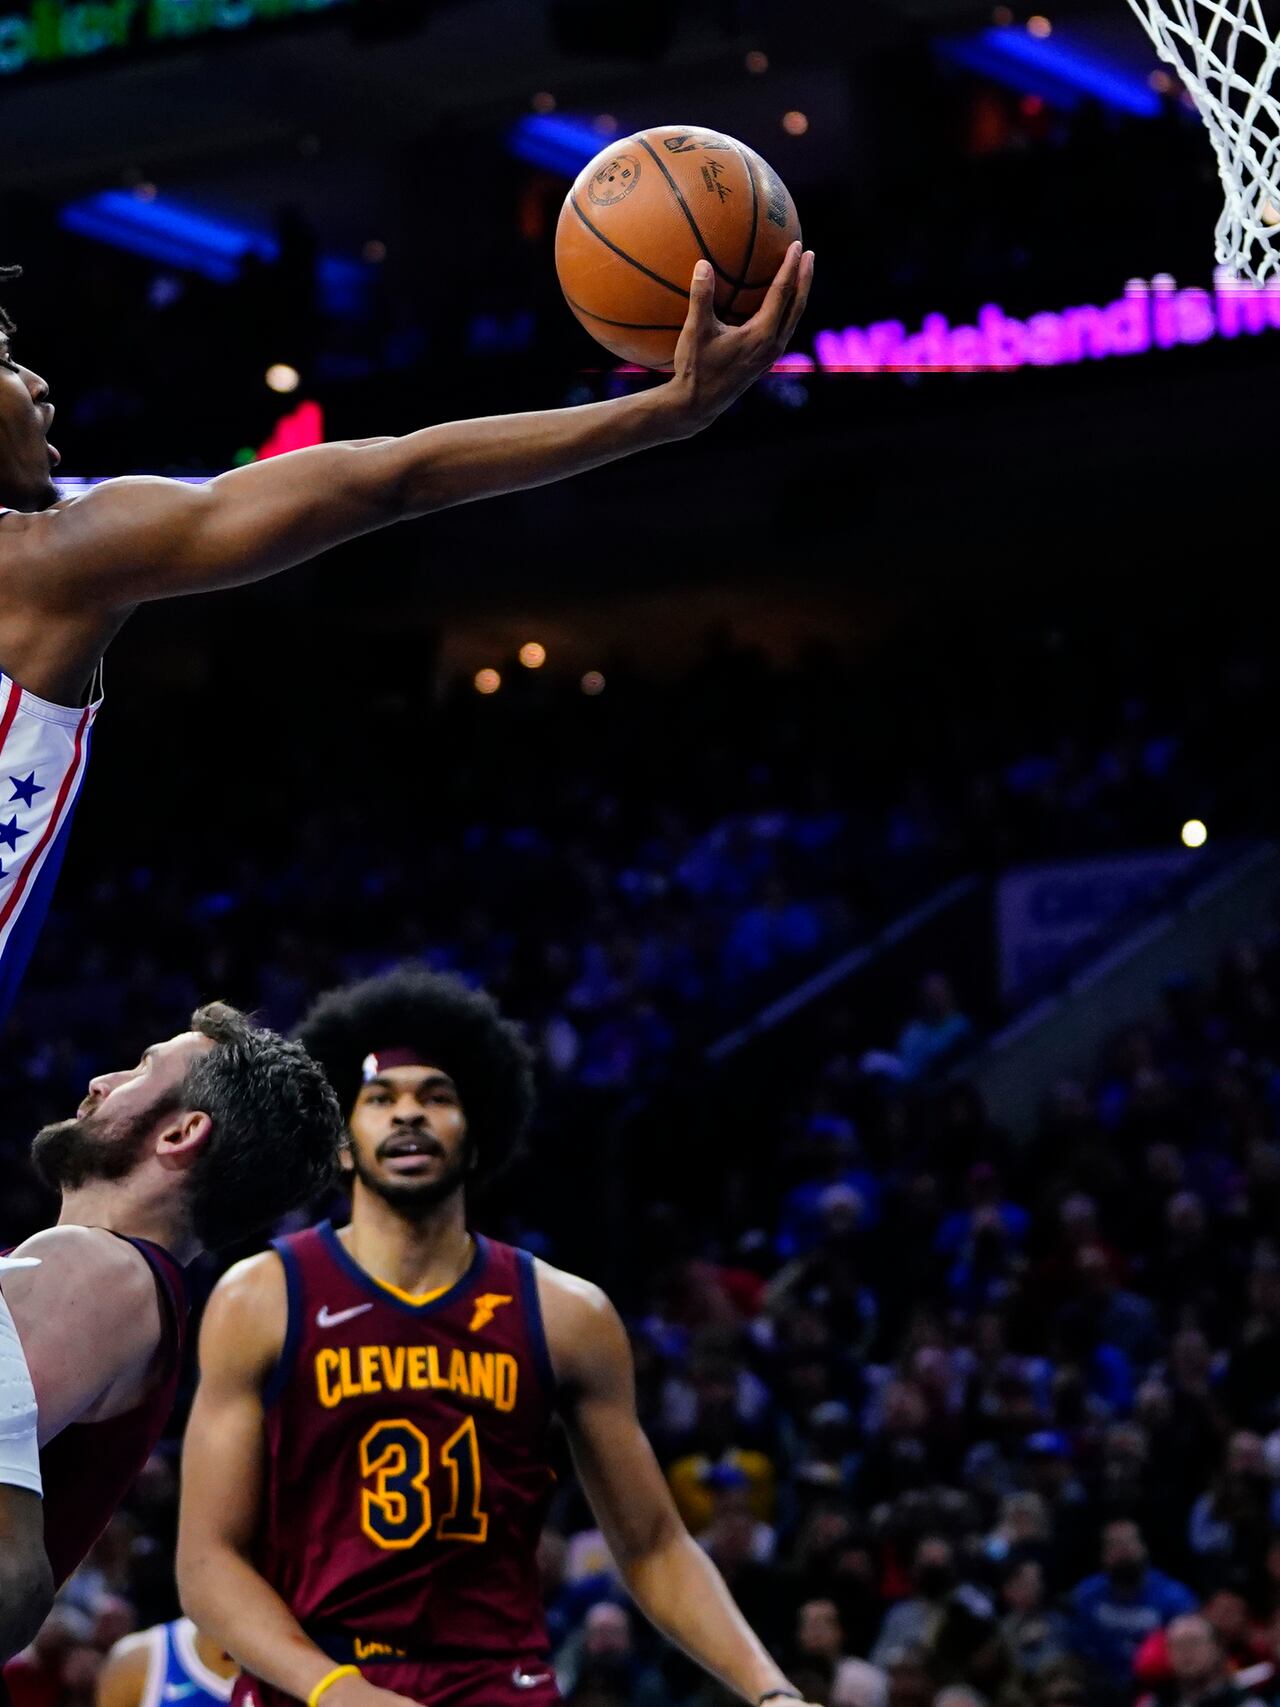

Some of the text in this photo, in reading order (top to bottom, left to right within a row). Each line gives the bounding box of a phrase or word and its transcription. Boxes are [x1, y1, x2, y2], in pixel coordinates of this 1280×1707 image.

[814, 277, 1150, 373] Wideband
[1150, 272, 1216, 350] is
[315, 1345, 518, 1412] CLEVELAND
[359, 1415, 489, 1550] 31
